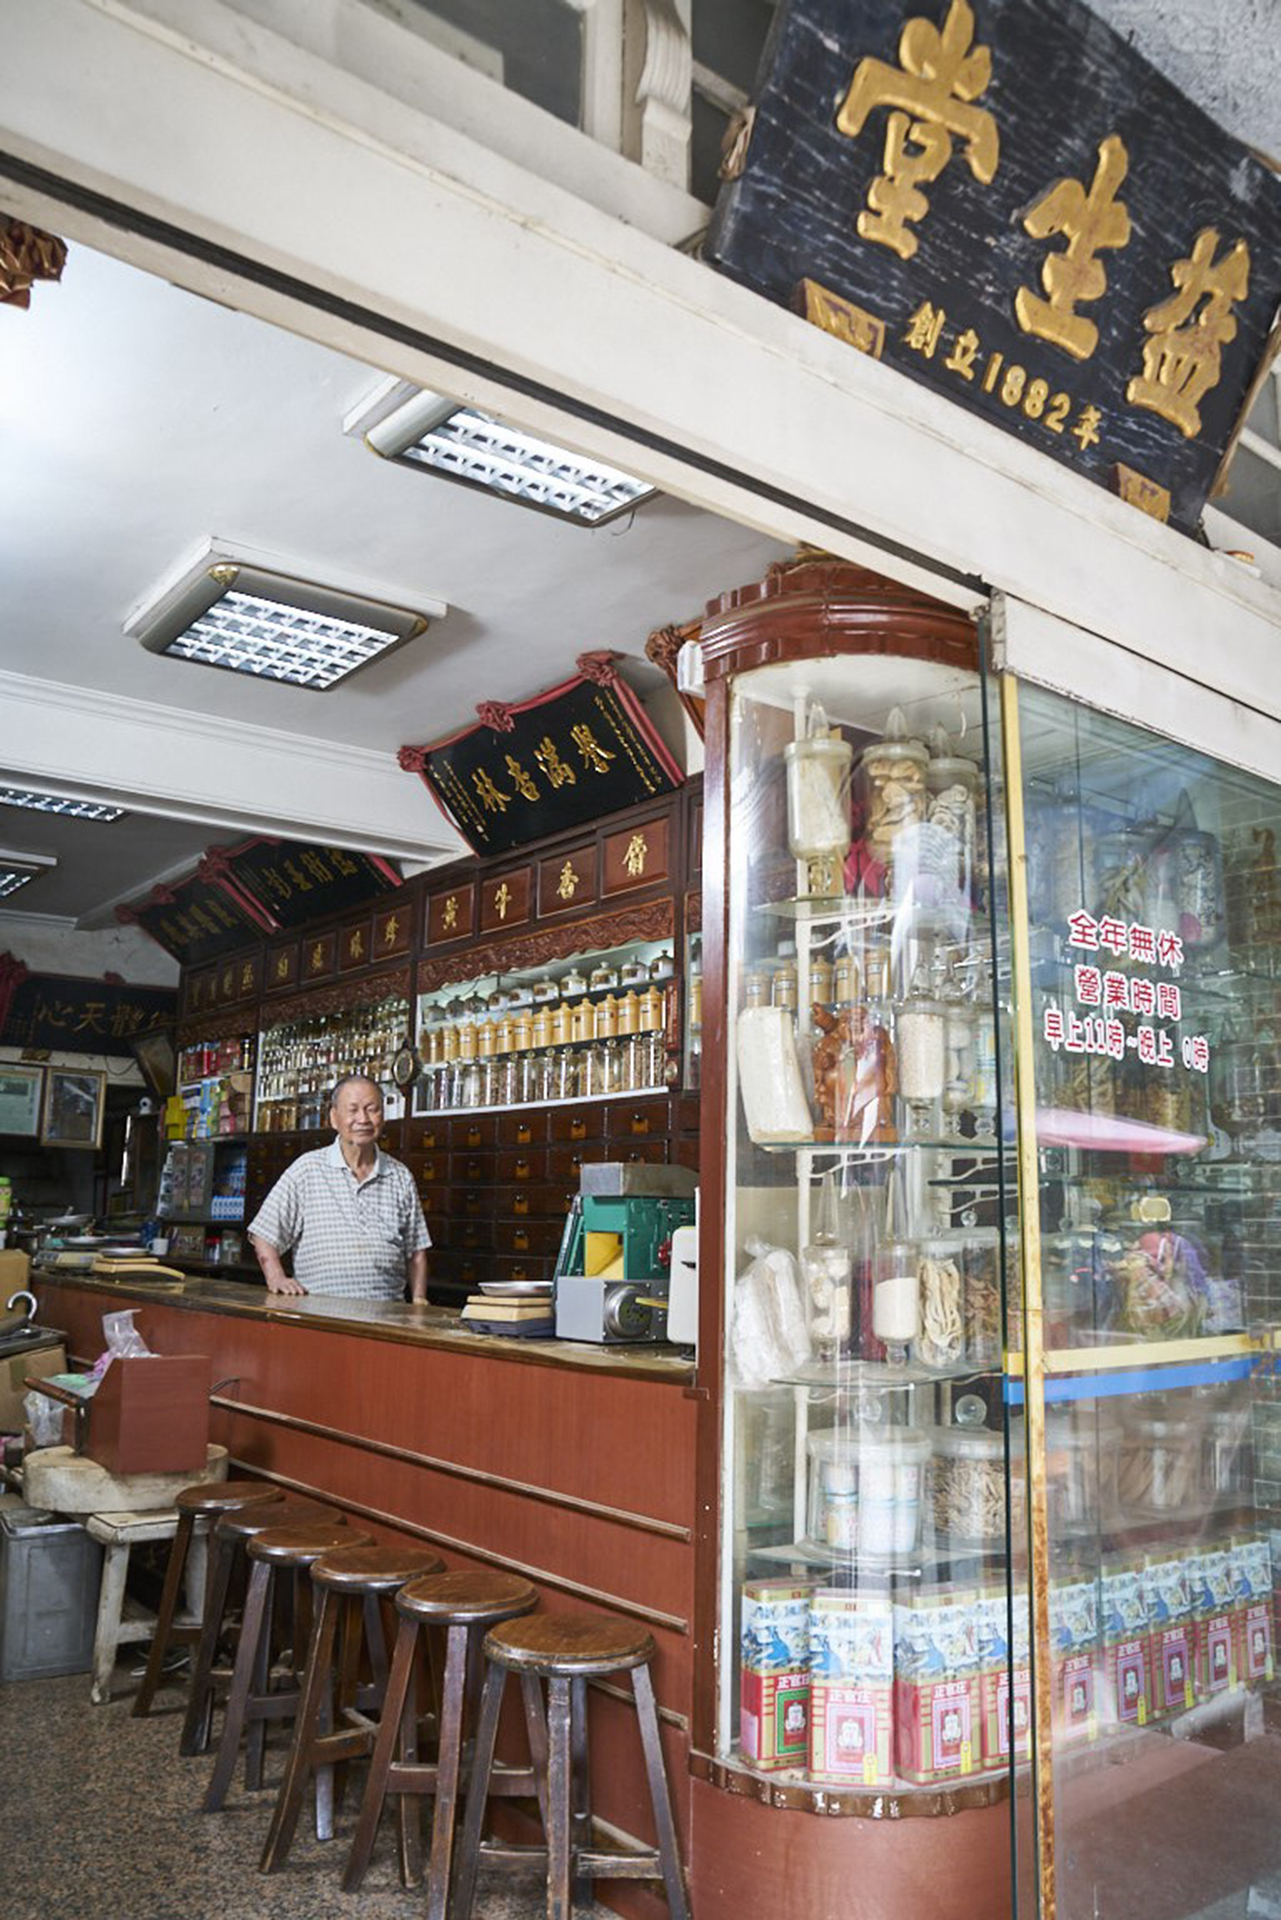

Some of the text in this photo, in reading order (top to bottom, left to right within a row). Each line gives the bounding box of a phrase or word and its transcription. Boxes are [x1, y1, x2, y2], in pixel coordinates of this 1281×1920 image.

[902, 302, 1101, 450] 創立1882年
[1068, 909, 1184, 966] 全年無休
[1075, 964, 1182, 1021] 營業時間
